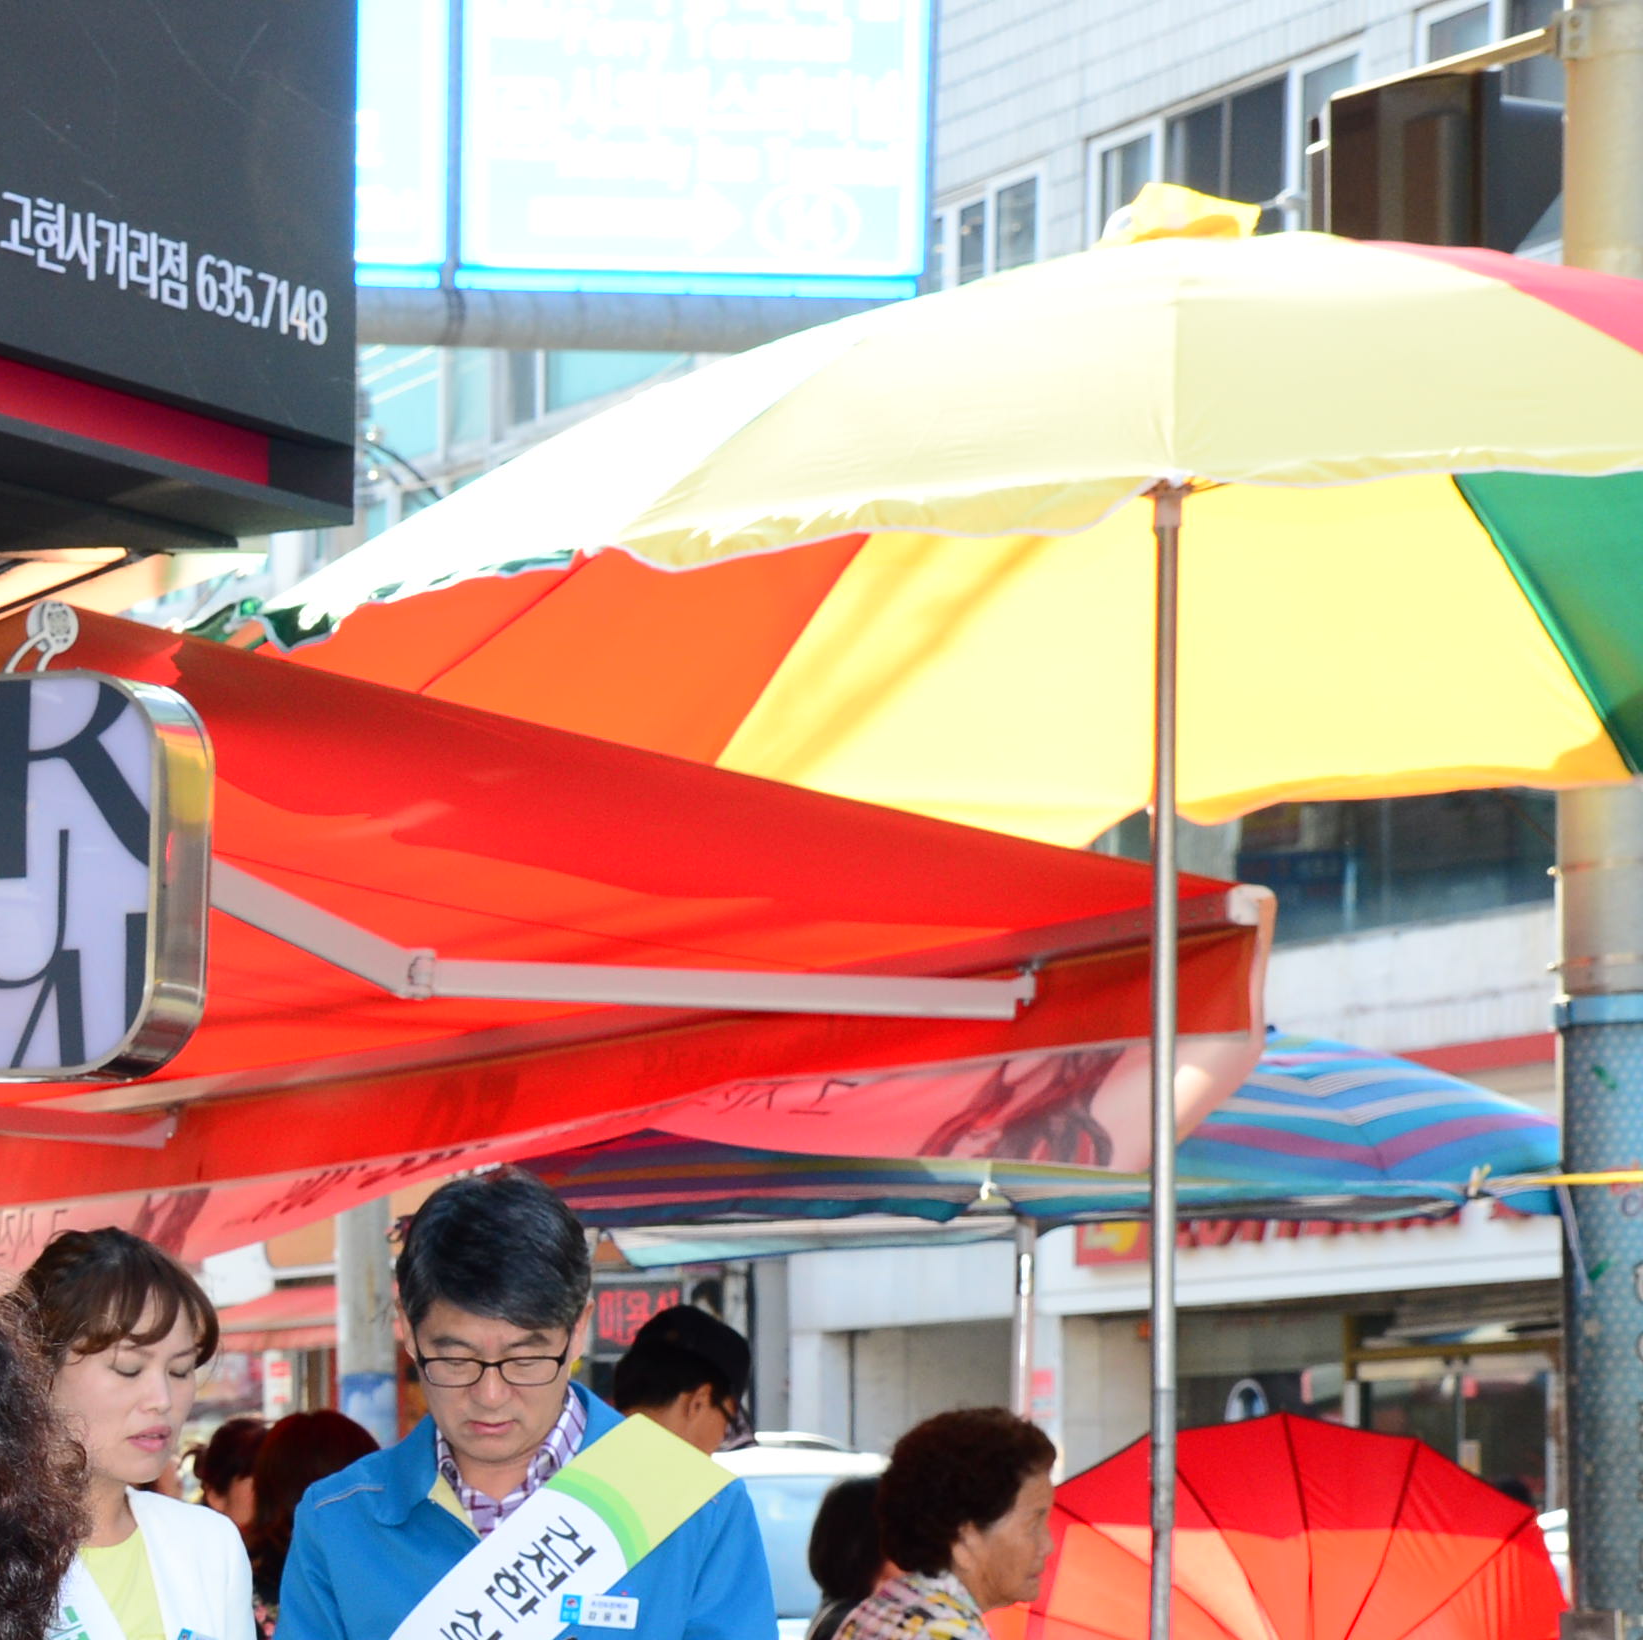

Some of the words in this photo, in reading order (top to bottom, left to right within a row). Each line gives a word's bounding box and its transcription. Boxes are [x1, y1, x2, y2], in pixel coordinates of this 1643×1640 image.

[0, 191, 188, 310] 고현사거리점
[196, 254, 329, 346] 635.7148
[598, 1287, 680, 1346] 미용
[483, 1514, 596, 1624] 건전한
